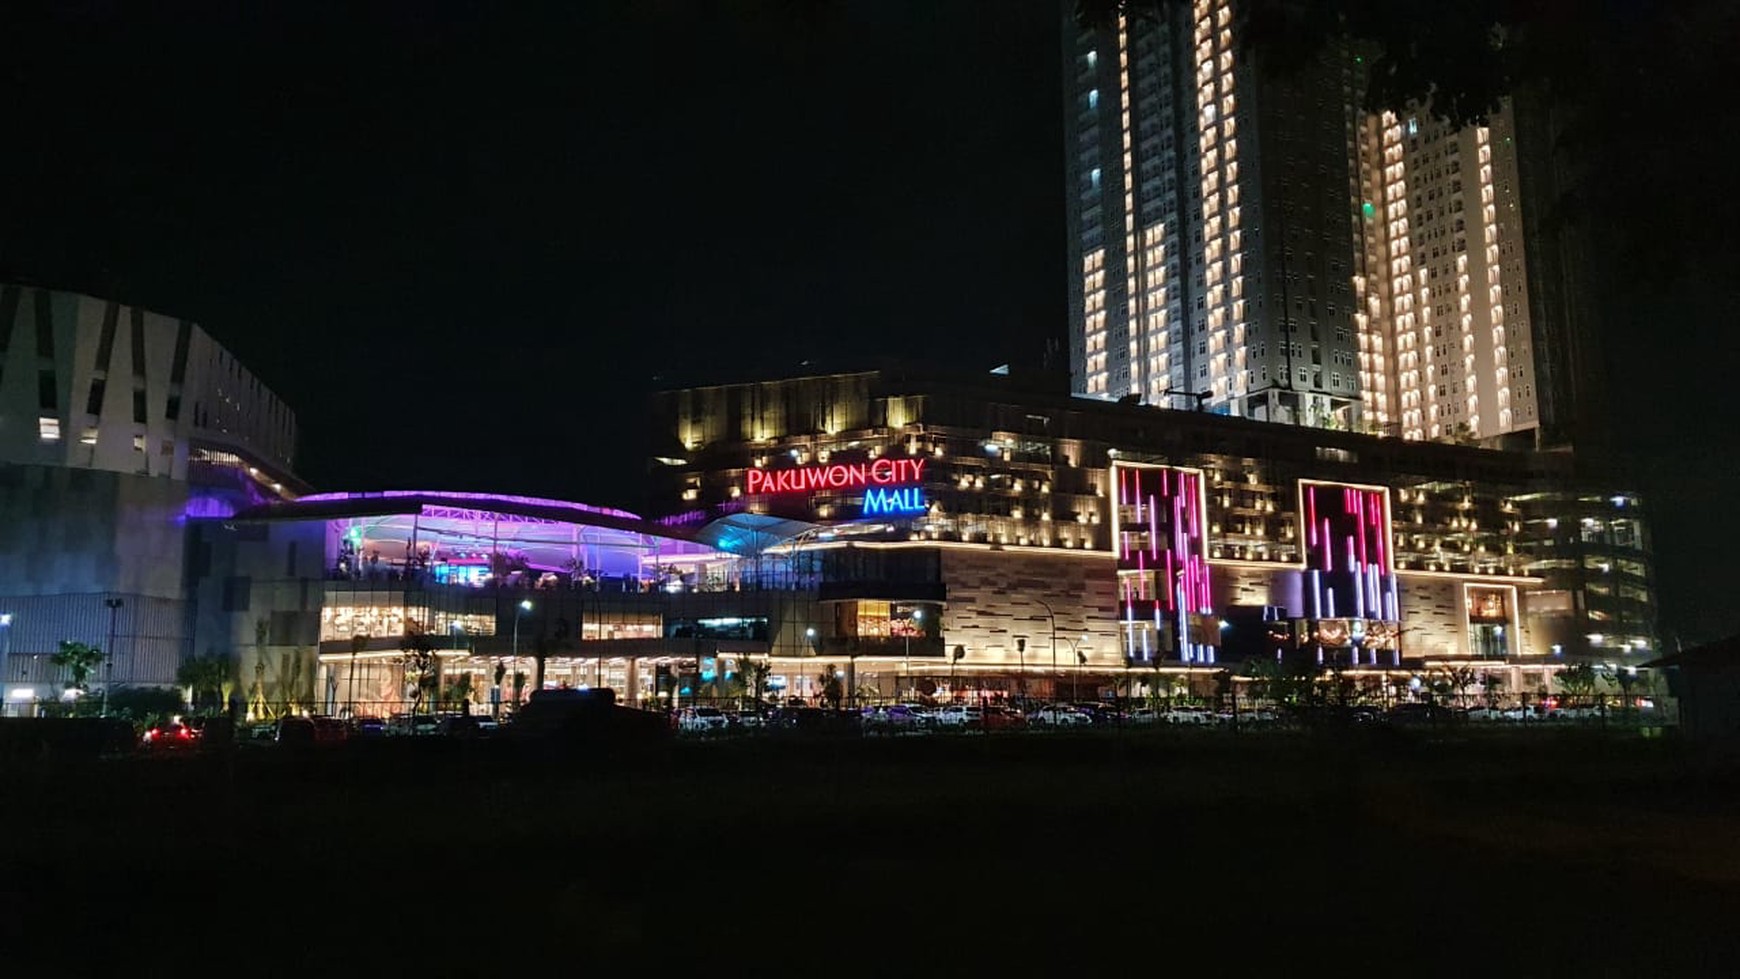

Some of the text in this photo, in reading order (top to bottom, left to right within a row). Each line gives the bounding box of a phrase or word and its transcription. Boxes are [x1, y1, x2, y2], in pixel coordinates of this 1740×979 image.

[748, 458, 925, 493] PAKUWON CITY
[863, 487, 925, 514] MALL
